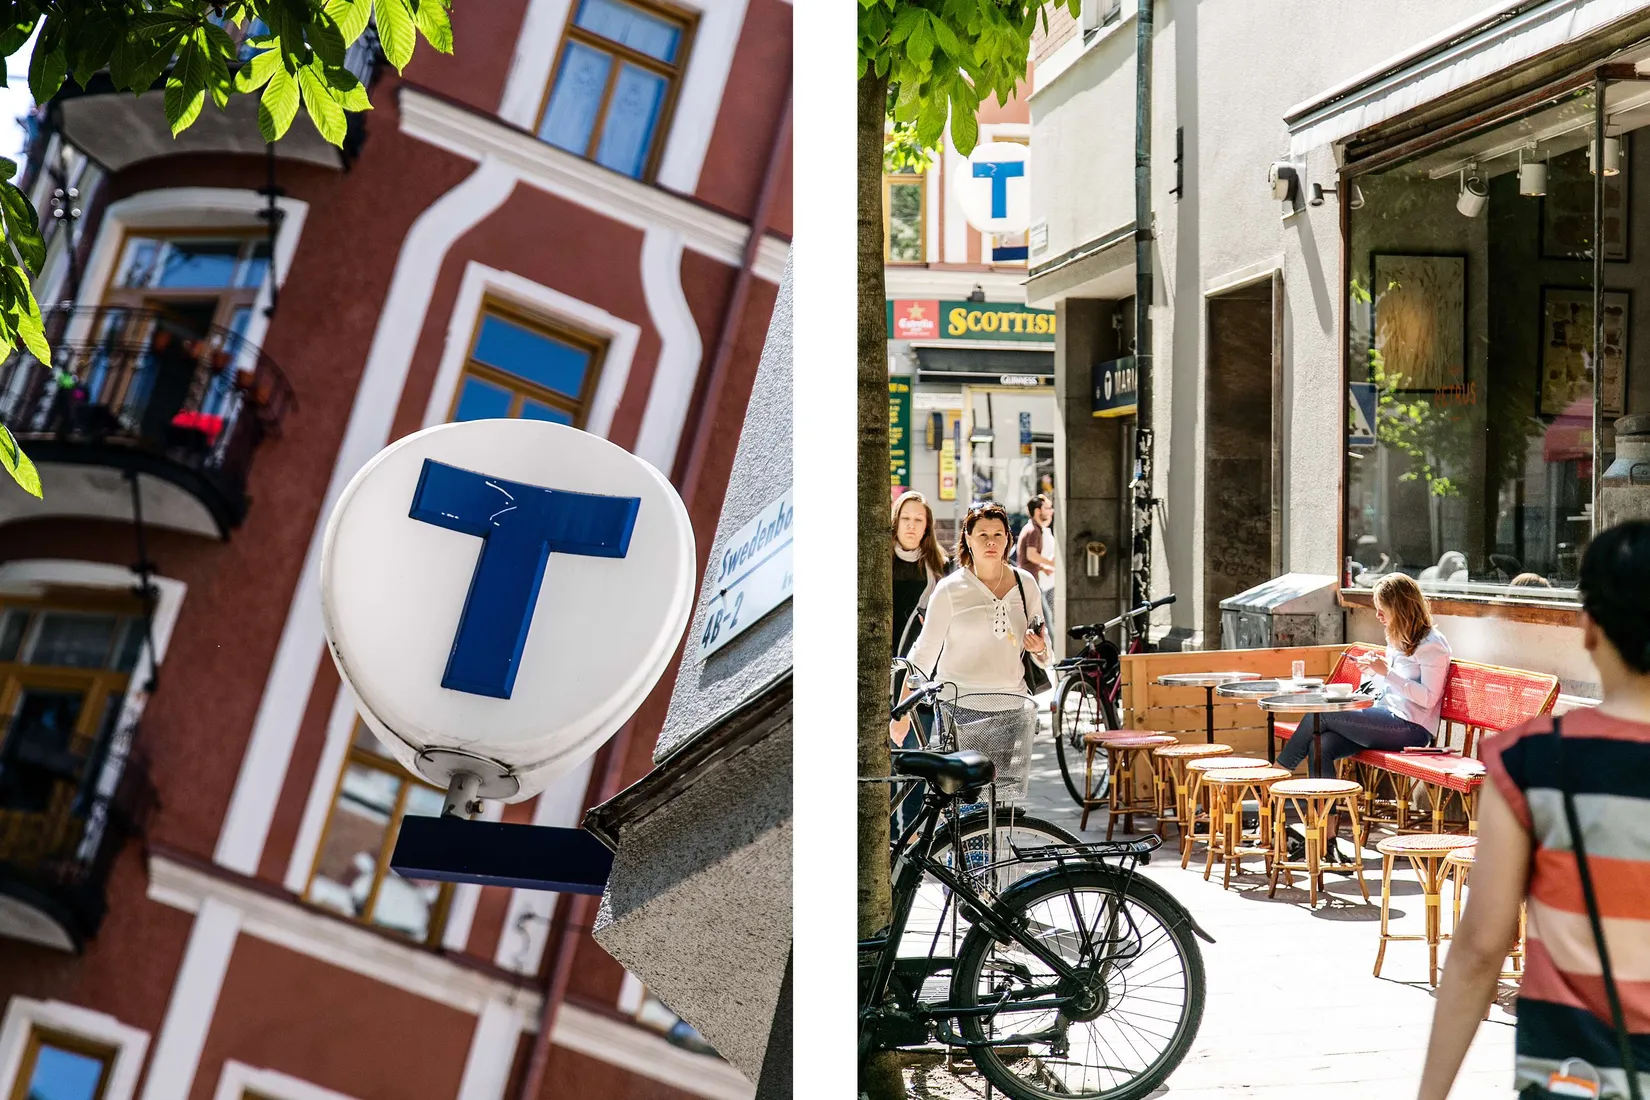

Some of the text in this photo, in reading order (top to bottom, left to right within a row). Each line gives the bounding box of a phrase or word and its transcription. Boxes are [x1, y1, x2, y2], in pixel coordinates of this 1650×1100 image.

[972, 160, 1025, 219] T
[1114, 367, 1136, 395] MARI
[718, 501, 793, 584] Swedenbo
[408, 457, 641, 699] T
[701, 591, 745, 649] 4B-2
